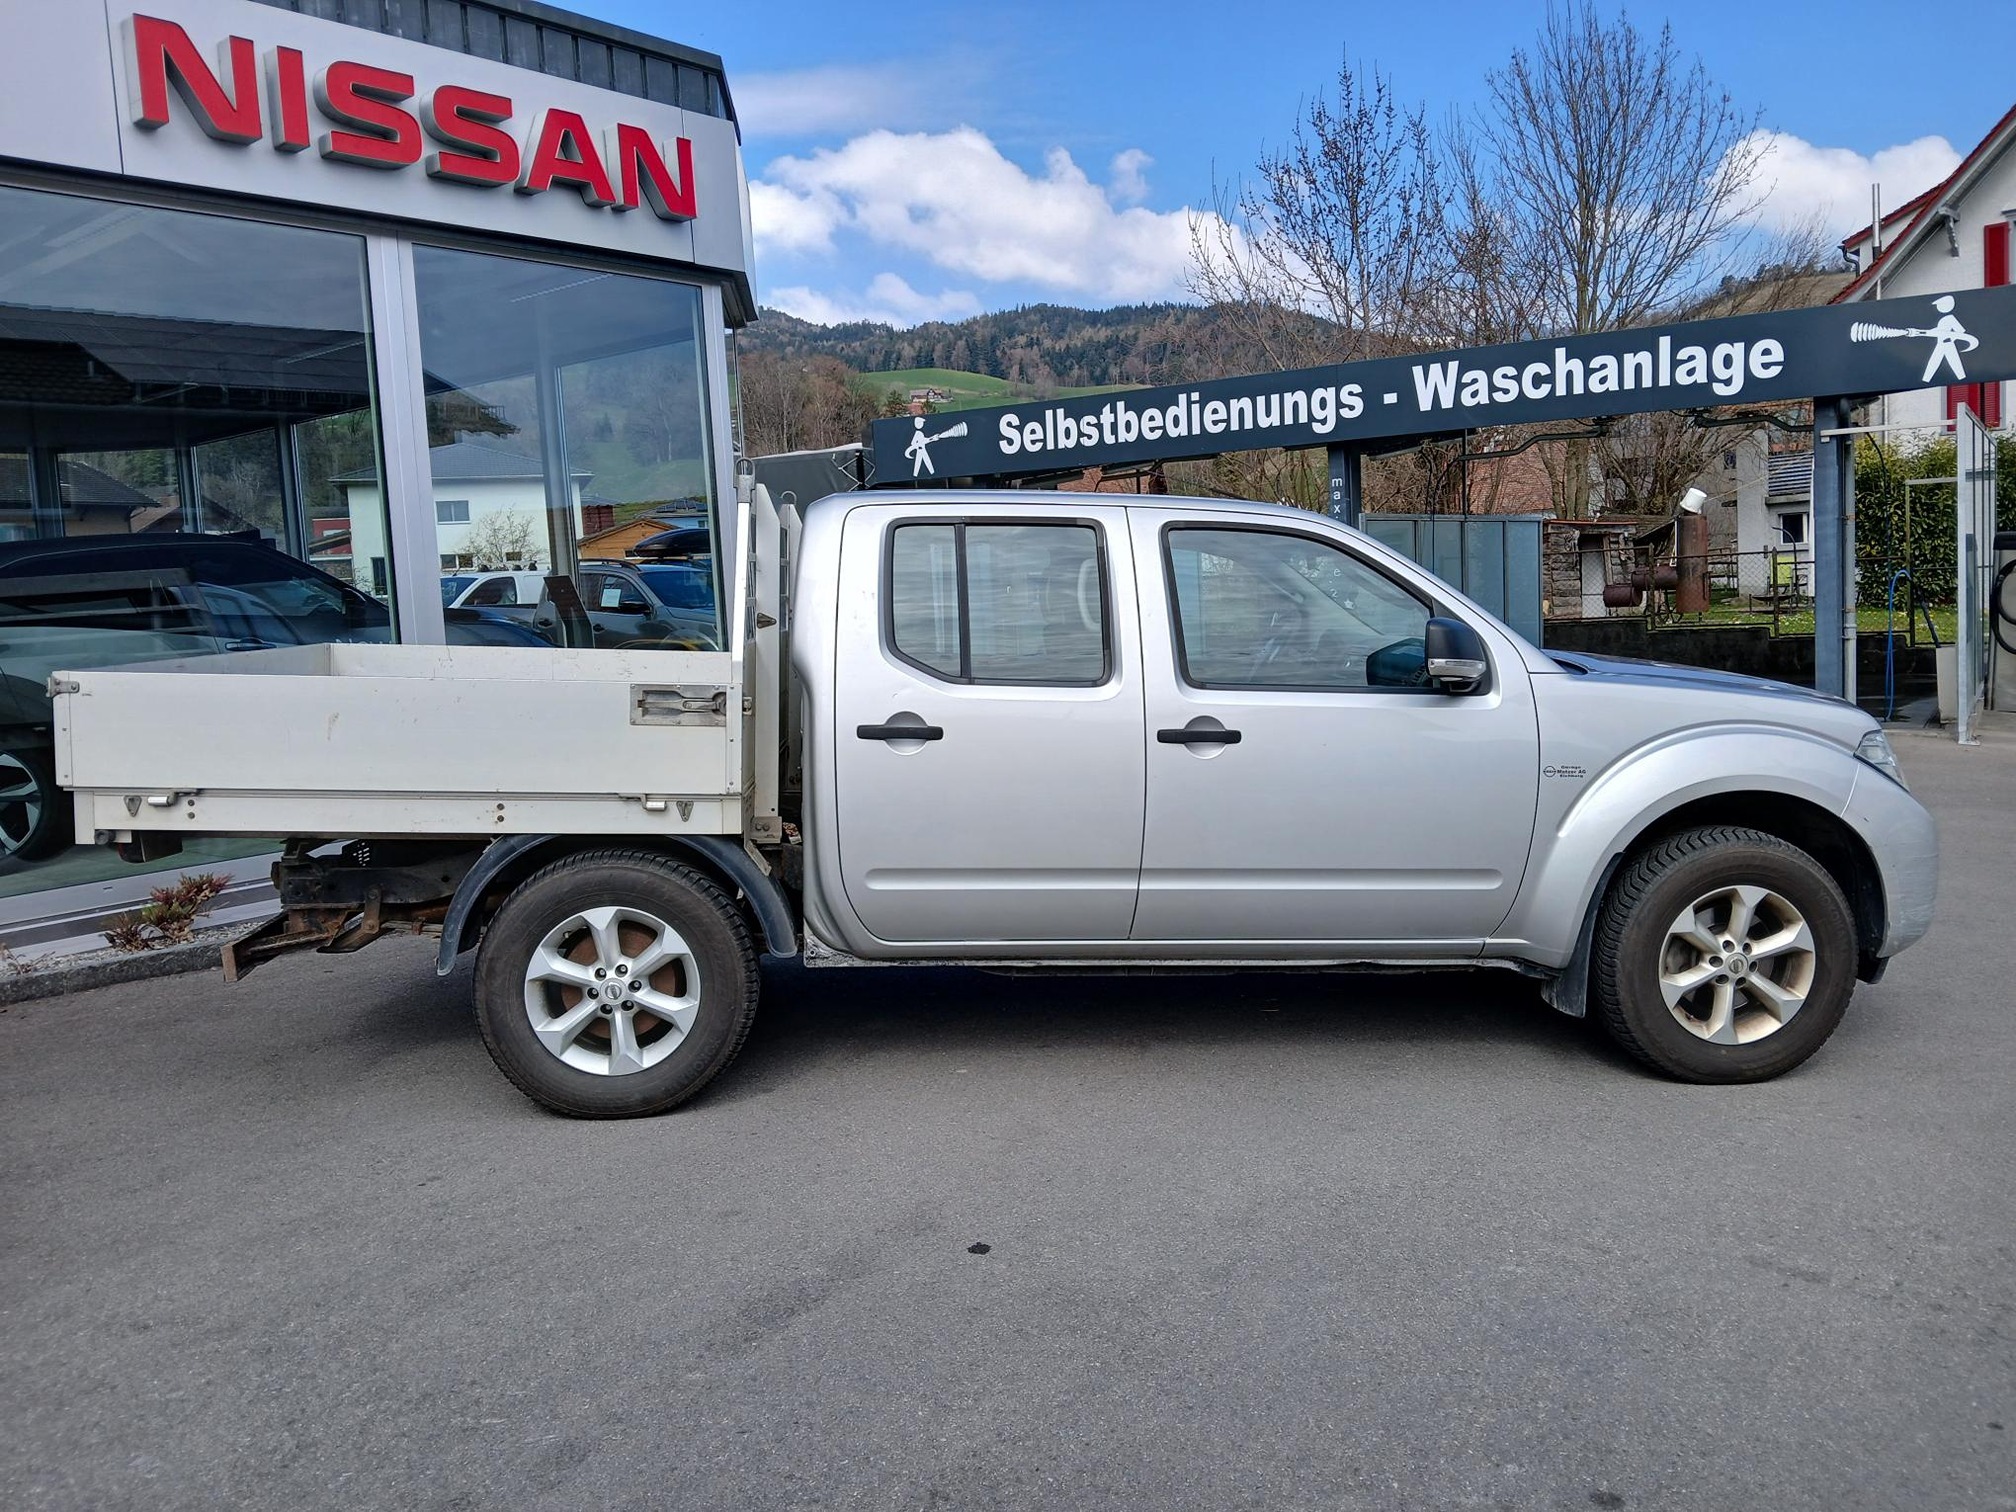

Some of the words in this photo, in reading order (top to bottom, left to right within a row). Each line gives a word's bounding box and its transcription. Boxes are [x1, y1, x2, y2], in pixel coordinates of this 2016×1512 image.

[132, 13, 697, 221] NISSAN
[999, 383, 1364, 454] Selbstbedienungs
[1411, 336, 1785, 412] Waschanlage
